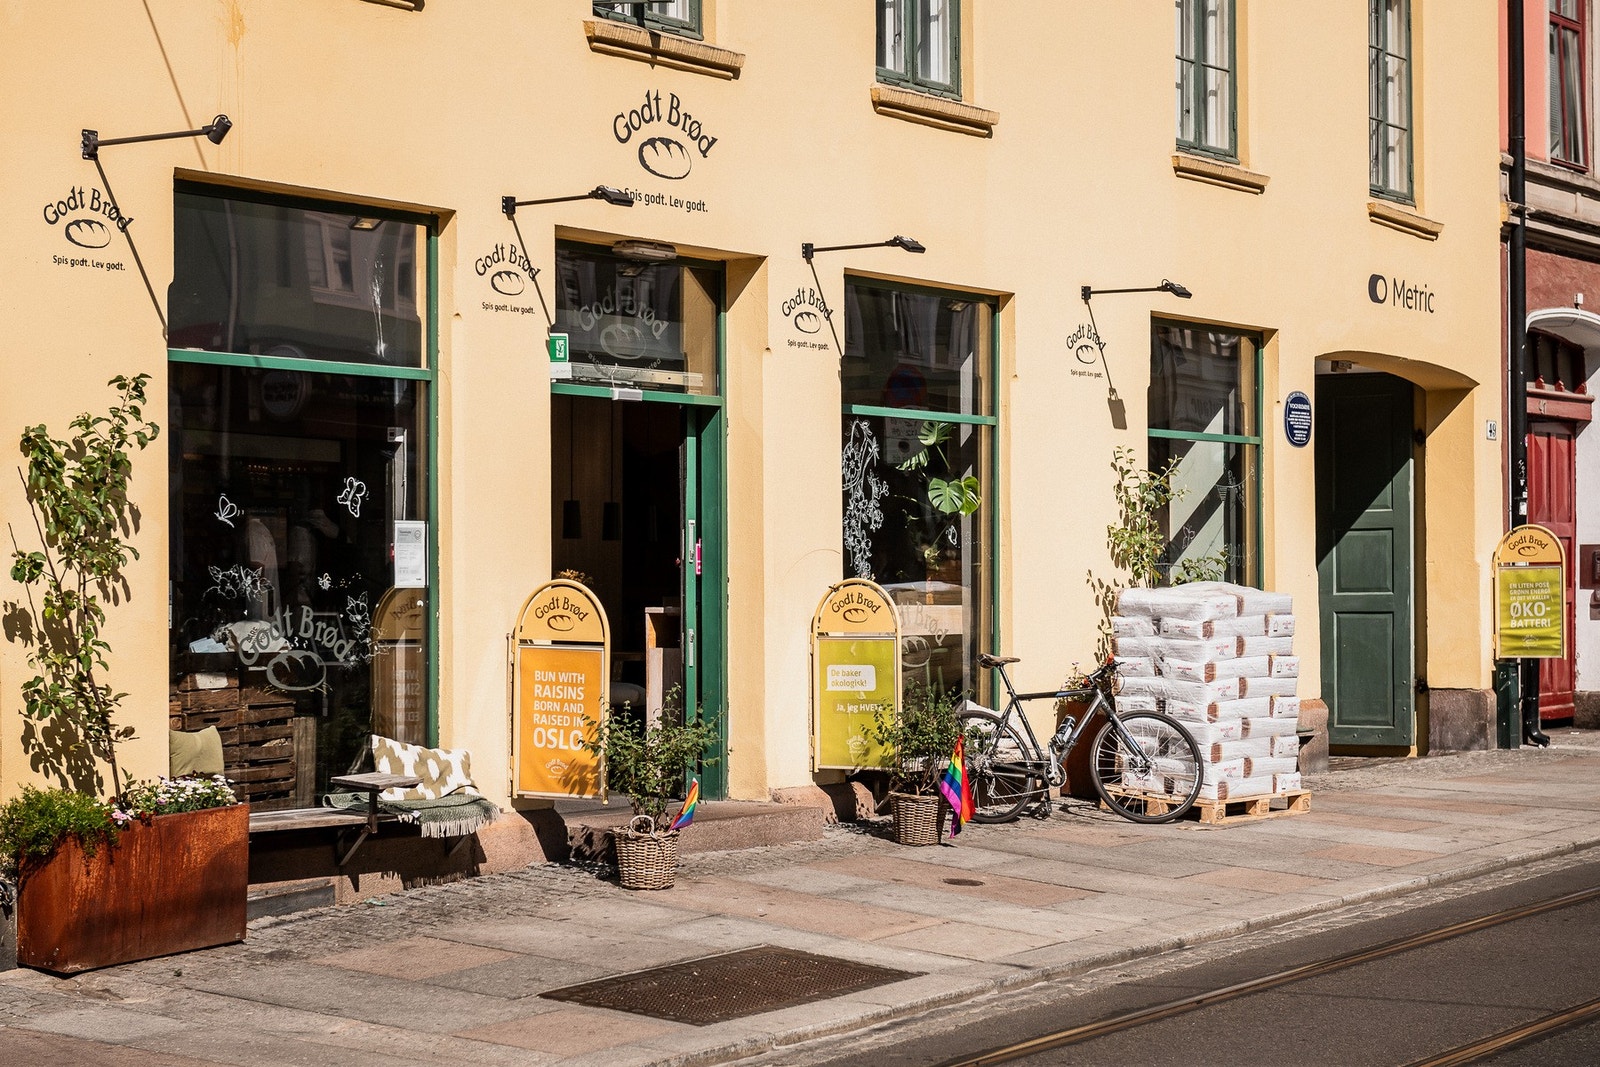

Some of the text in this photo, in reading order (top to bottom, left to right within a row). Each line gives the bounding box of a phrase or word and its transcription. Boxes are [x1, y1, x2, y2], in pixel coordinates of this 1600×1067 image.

[613, 88, 719, 158] Godt Brød
[43, 186, 134, 233] Godt Brød
[644, 192, 668, 206] godt.
[669, 195, 684, 208] Lev
[686, 199, 709, 213] godt.
[52, 254, 126, 272] Spis godt. Lev godt.
[475, 242, 541, 282] Godt Brød
[781, 286, 834, 322] Godt Brød
[1392, 277, 1435, 314] Metric
[481, 301, 536, 316] Spis godt. Lev godt.
[579, 284, 620, 332] Godt
[1066, 323, 1085, 350] Godt
[1508, 534, 1549, 551] Godt Brød
[534, 596, 589, 622] Godt Brød
[831, 592, 882, 614] Godt Brød
[1510, 600, 1551, 619] ØKO-
[1510, 618, 1551, 628] BATTERI
[238, 604, 358, 666] Godt Brød
[534, 670, 585, 684] BUN WITH
[830, 668, 862, 677] De baker
[534, 684, 585, 700] RAISINS
[533, 700, 585, 714] BORN AND
[836, 703, 846, 712] Ja,
[847, 702, 859, 713] jeg
[533, 713, 584, 728] RAISED IN
[533, 727, 584, 751] OSLO
